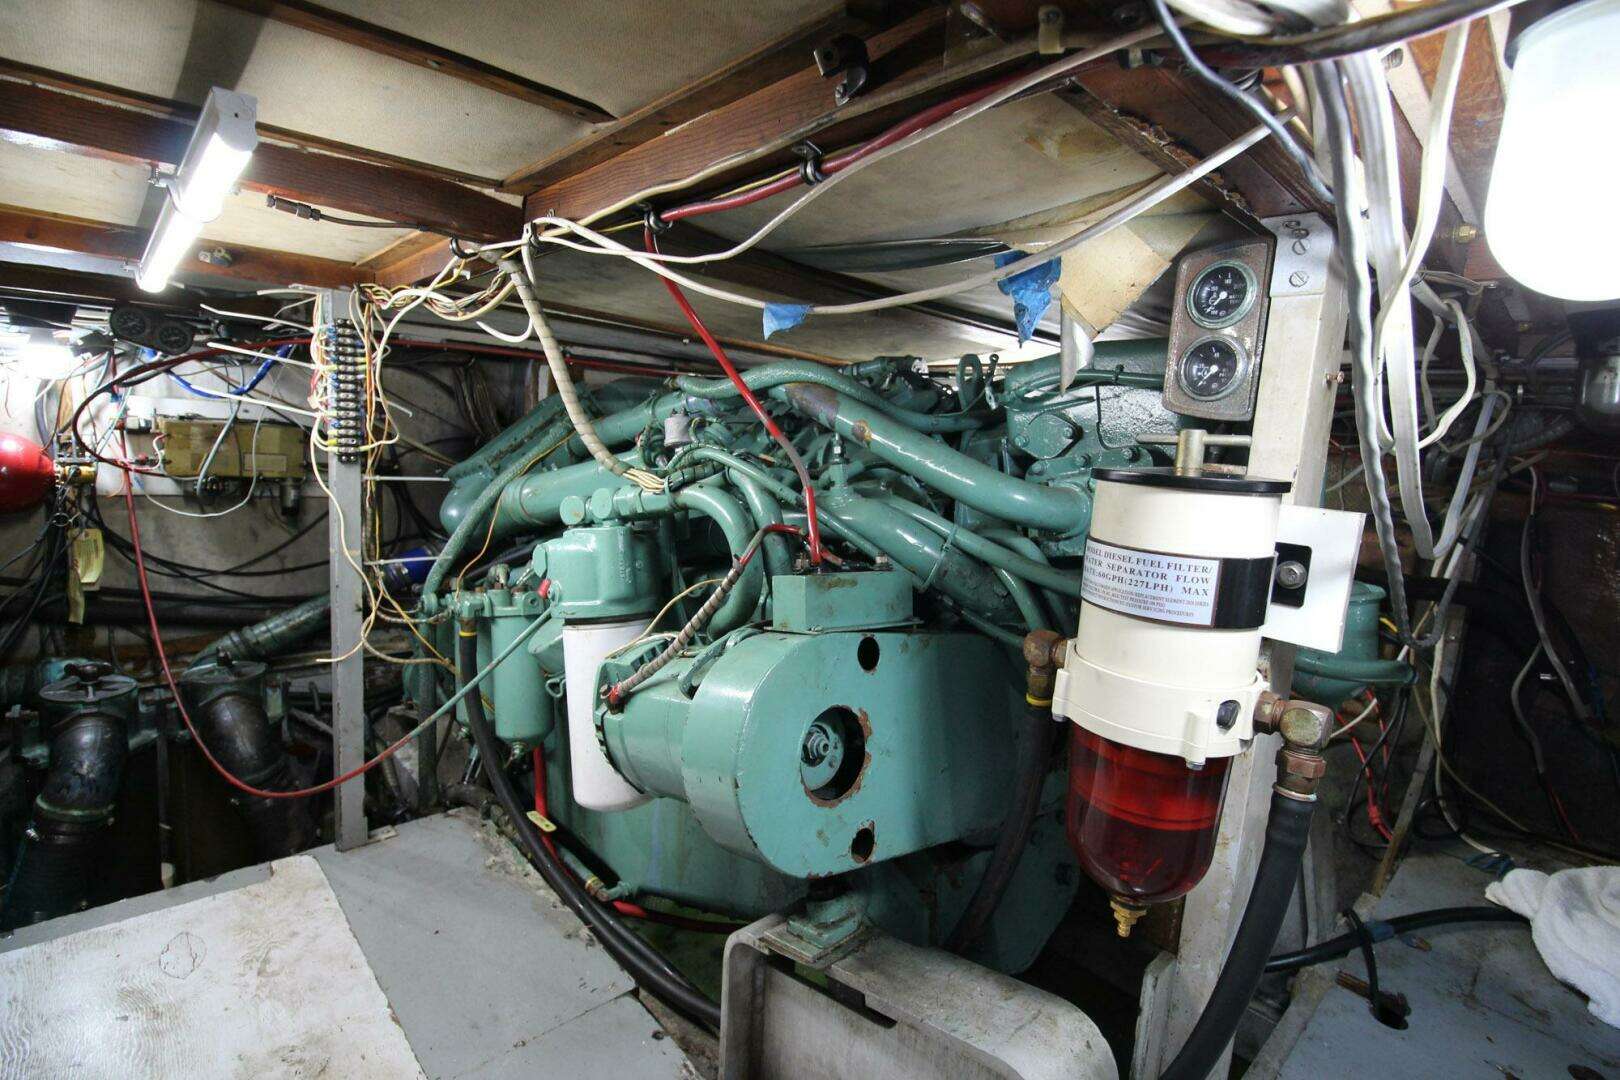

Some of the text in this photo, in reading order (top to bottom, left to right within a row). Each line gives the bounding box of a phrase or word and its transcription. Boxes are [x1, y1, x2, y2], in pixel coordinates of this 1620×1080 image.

[1136, 558, 1164, 569] FUEL
[1106, 563, 1168, 581] SEPARATOR
[1175, 574, 1209, 585] FLOW
[1182, 586, 1209, 597] MAX
